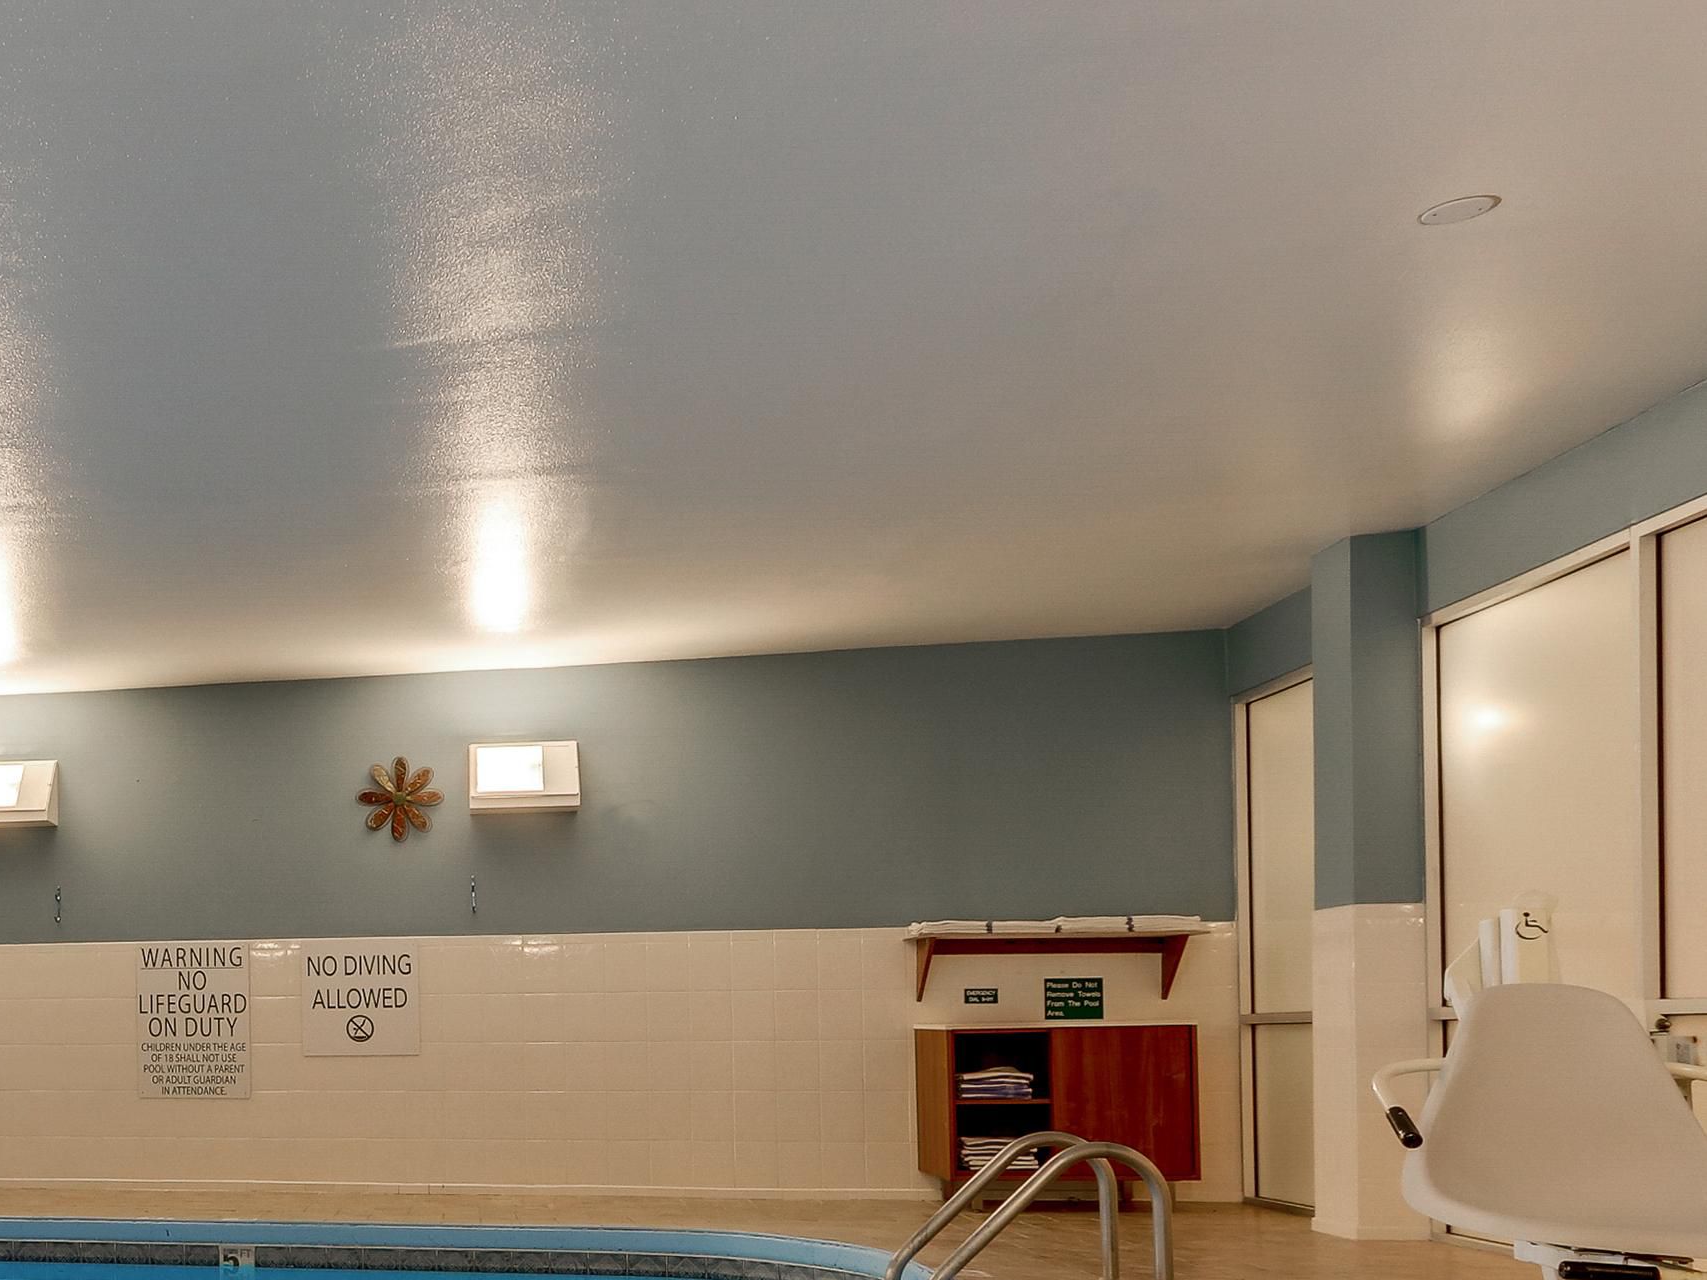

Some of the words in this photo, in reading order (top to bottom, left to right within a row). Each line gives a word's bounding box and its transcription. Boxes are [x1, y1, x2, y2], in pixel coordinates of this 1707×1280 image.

[141, 946, 243, 968] WARNING
[307, 955, 337, 977] NO
[344, 954, 412, 976] DIVING
[178, 970, 207, 991] NO
[139, 993, 247, 1014] LIFEGUARD
[312, 987, 408, 1009] ALLOWED
[1077, 990, 1101, 998] Towels
[148, 1017, 177, 1037] ON
[185, 1017, 238, 1037] DUTY
[141, 1042, 181, 1052] CHILDREN
[183, 1042, 211, 1052] UNDER
[213, 1042, 228, 1052] THE
[230, 1042, 246, 1052] AGE
[151, 1053, 162, 1063] OF
[164, 1053, 174, 1063] 18
[175, 1053, 201, 1063] SHALL
[202, 1053, 220, 1063] NOT
[221, 1053, 237, 1063] USE
[143, 1064, 165, 1074] POOL
[167, 1064, 205, 1074] WITHOUT
[206, 1064, 213, 1074] A
[214, 1064, 245, 1074] PARENT
[151, 1075, 164, 1085] OR
[165, 1075, 192, 1085] ADULT
[193, 1075, 237, 1085] GUARDIAN
[161, 1086, 170, 1096] IN
[172, 1086, 228, 1096] ATTENDANCE.
[223, 1248, 239, 1267] 5
[239, 1248, 252, 1258] FT
